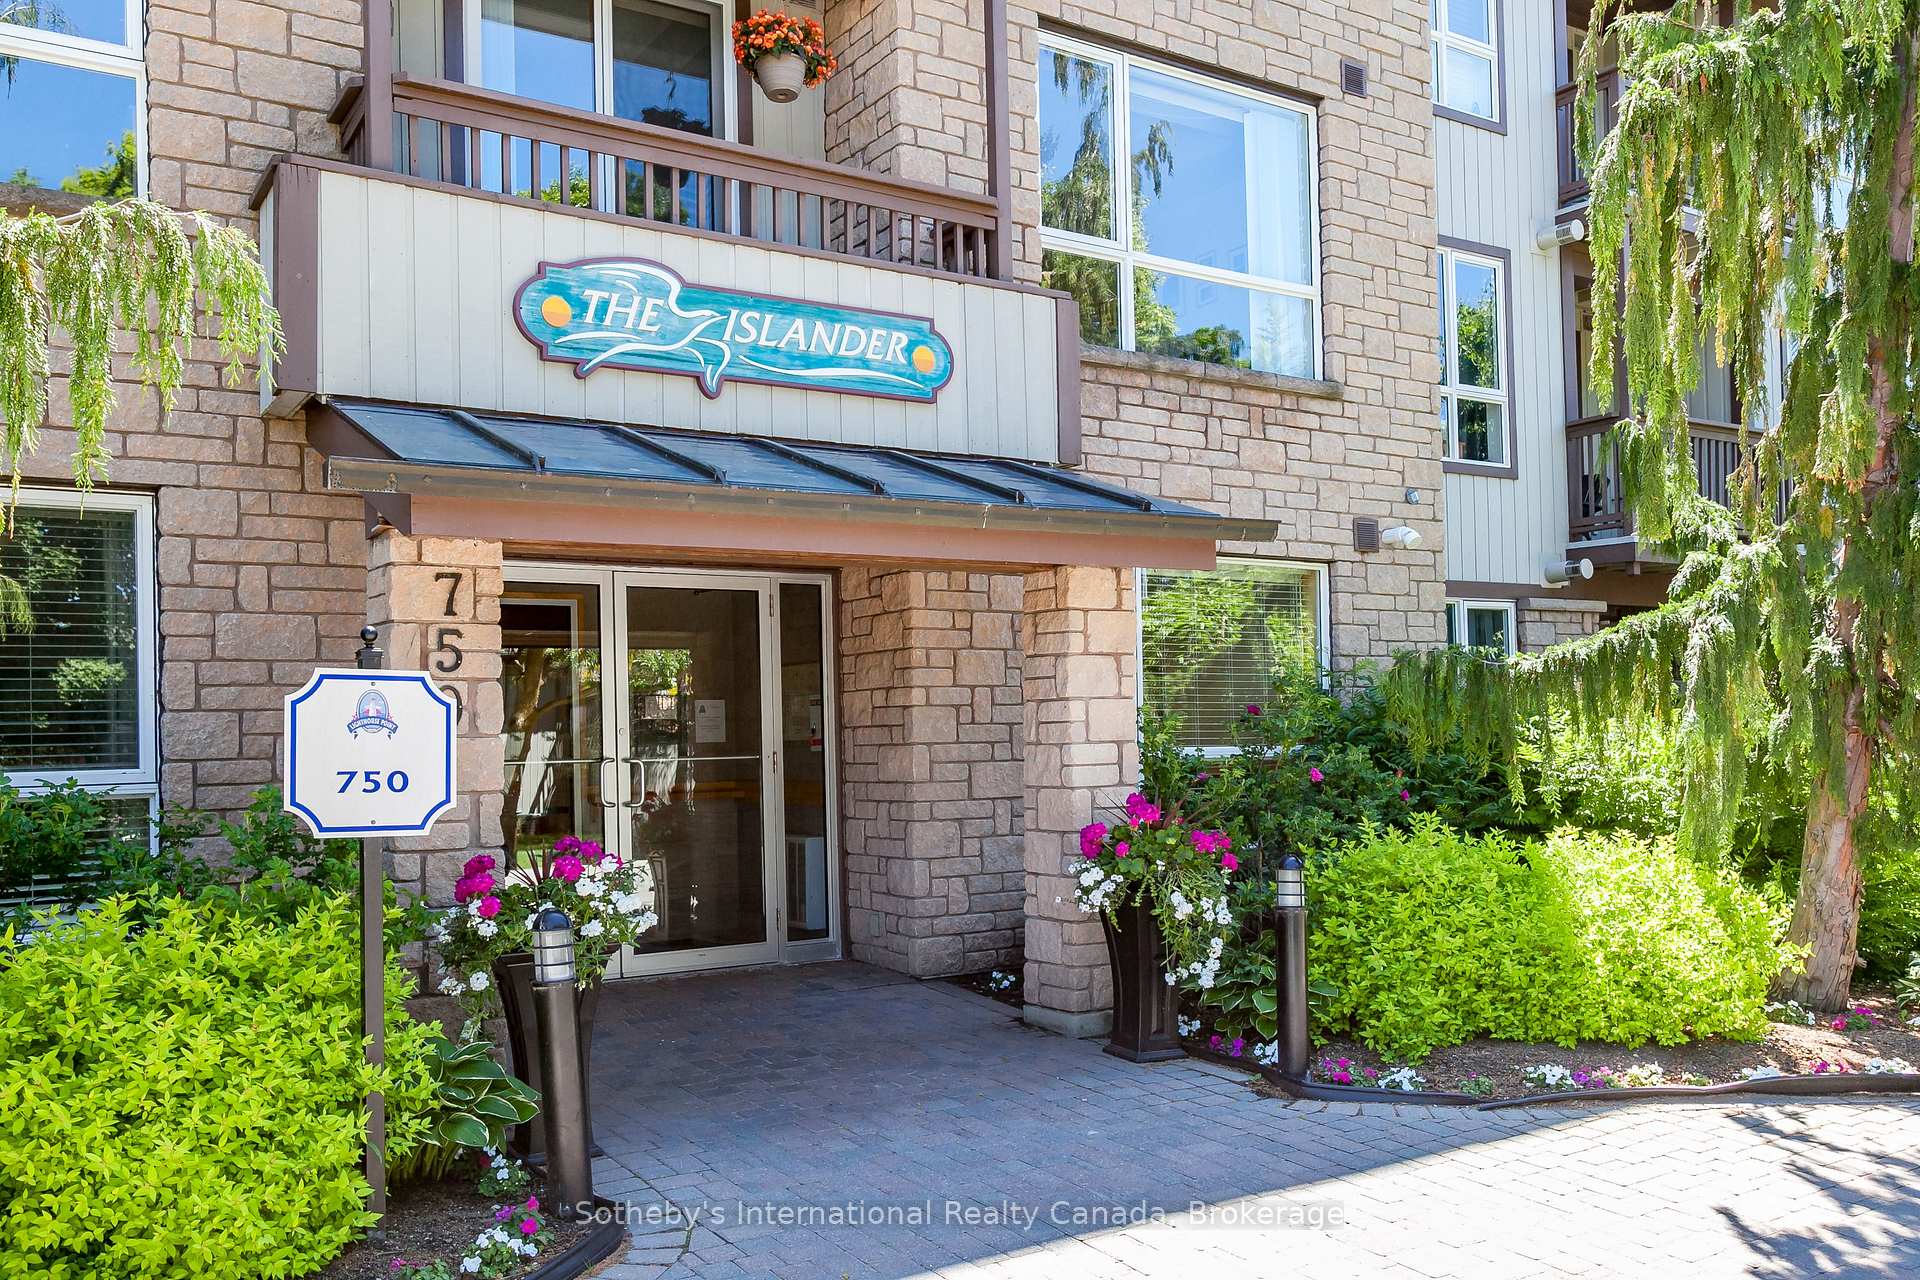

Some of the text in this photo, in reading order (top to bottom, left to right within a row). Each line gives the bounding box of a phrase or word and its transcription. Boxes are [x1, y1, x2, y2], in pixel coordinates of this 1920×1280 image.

[582, 289, 908, 363] THE ISLANDER
[380, 719, 396, 730] POINT
[336, 770, 409, 793] 750
